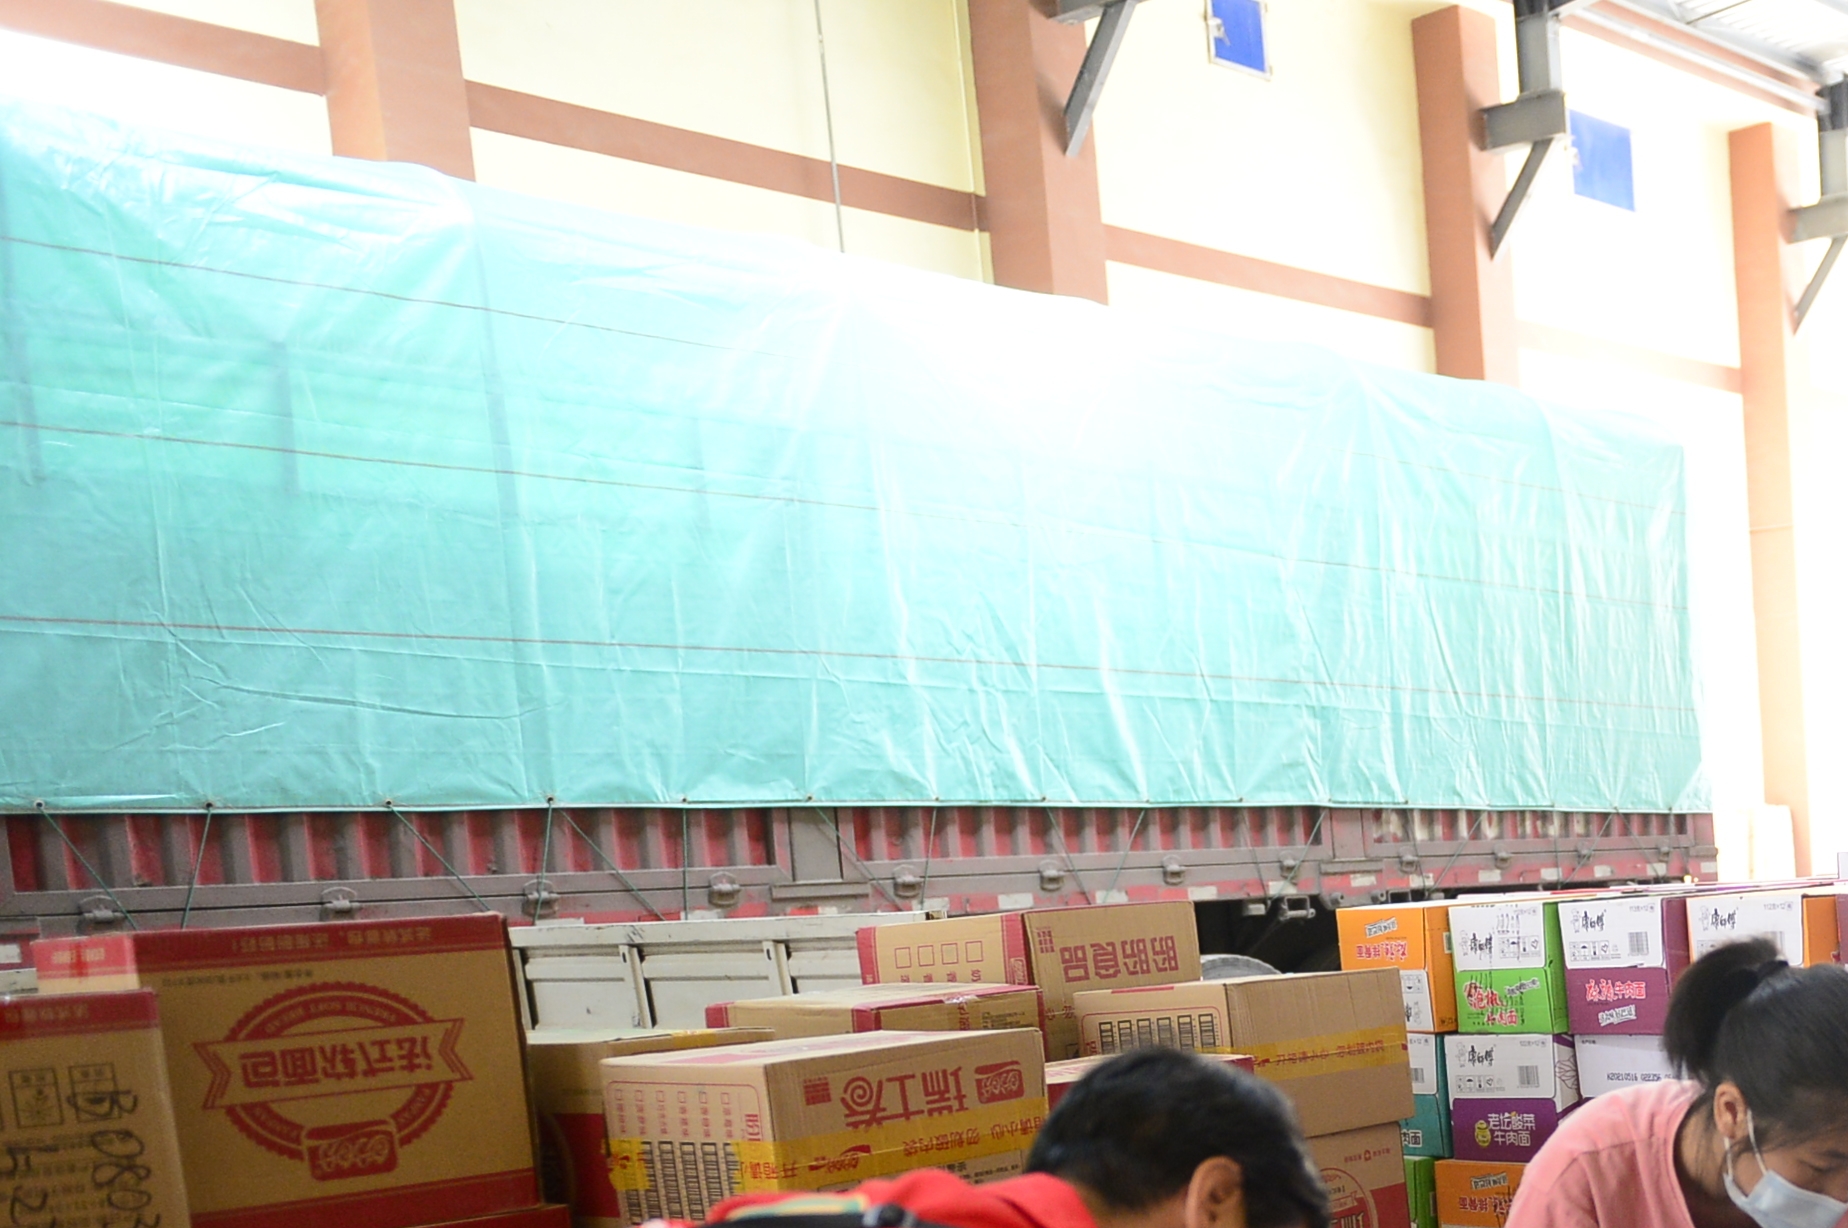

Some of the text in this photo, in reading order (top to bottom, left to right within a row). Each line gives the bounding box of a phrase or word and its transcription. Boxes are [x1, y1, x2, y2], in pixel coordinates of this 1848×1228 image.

[1581, 909, 1607, 932] 康师傅
[1710, 906, 1739, 931] 康师傅
[1469, 933, 1494, 953] 康师傅
[1059, 936, 1180, 983] 盼盼食品
[1585, 979, 1647, 1002] 麻辣牛肉面
[239, 1036, 433, 1090] 法式软面包
[1468, 1044, 1497, 1069] 康师傅
[839, 1065, 968, 1131] 瑞士卷
[1488, 1112, 1536, 1131] 老坛酸菜
[901, 1128, 981, 1158] 勿划破内袋
[1493, 1130, 1531, 1147] 牛肉面
